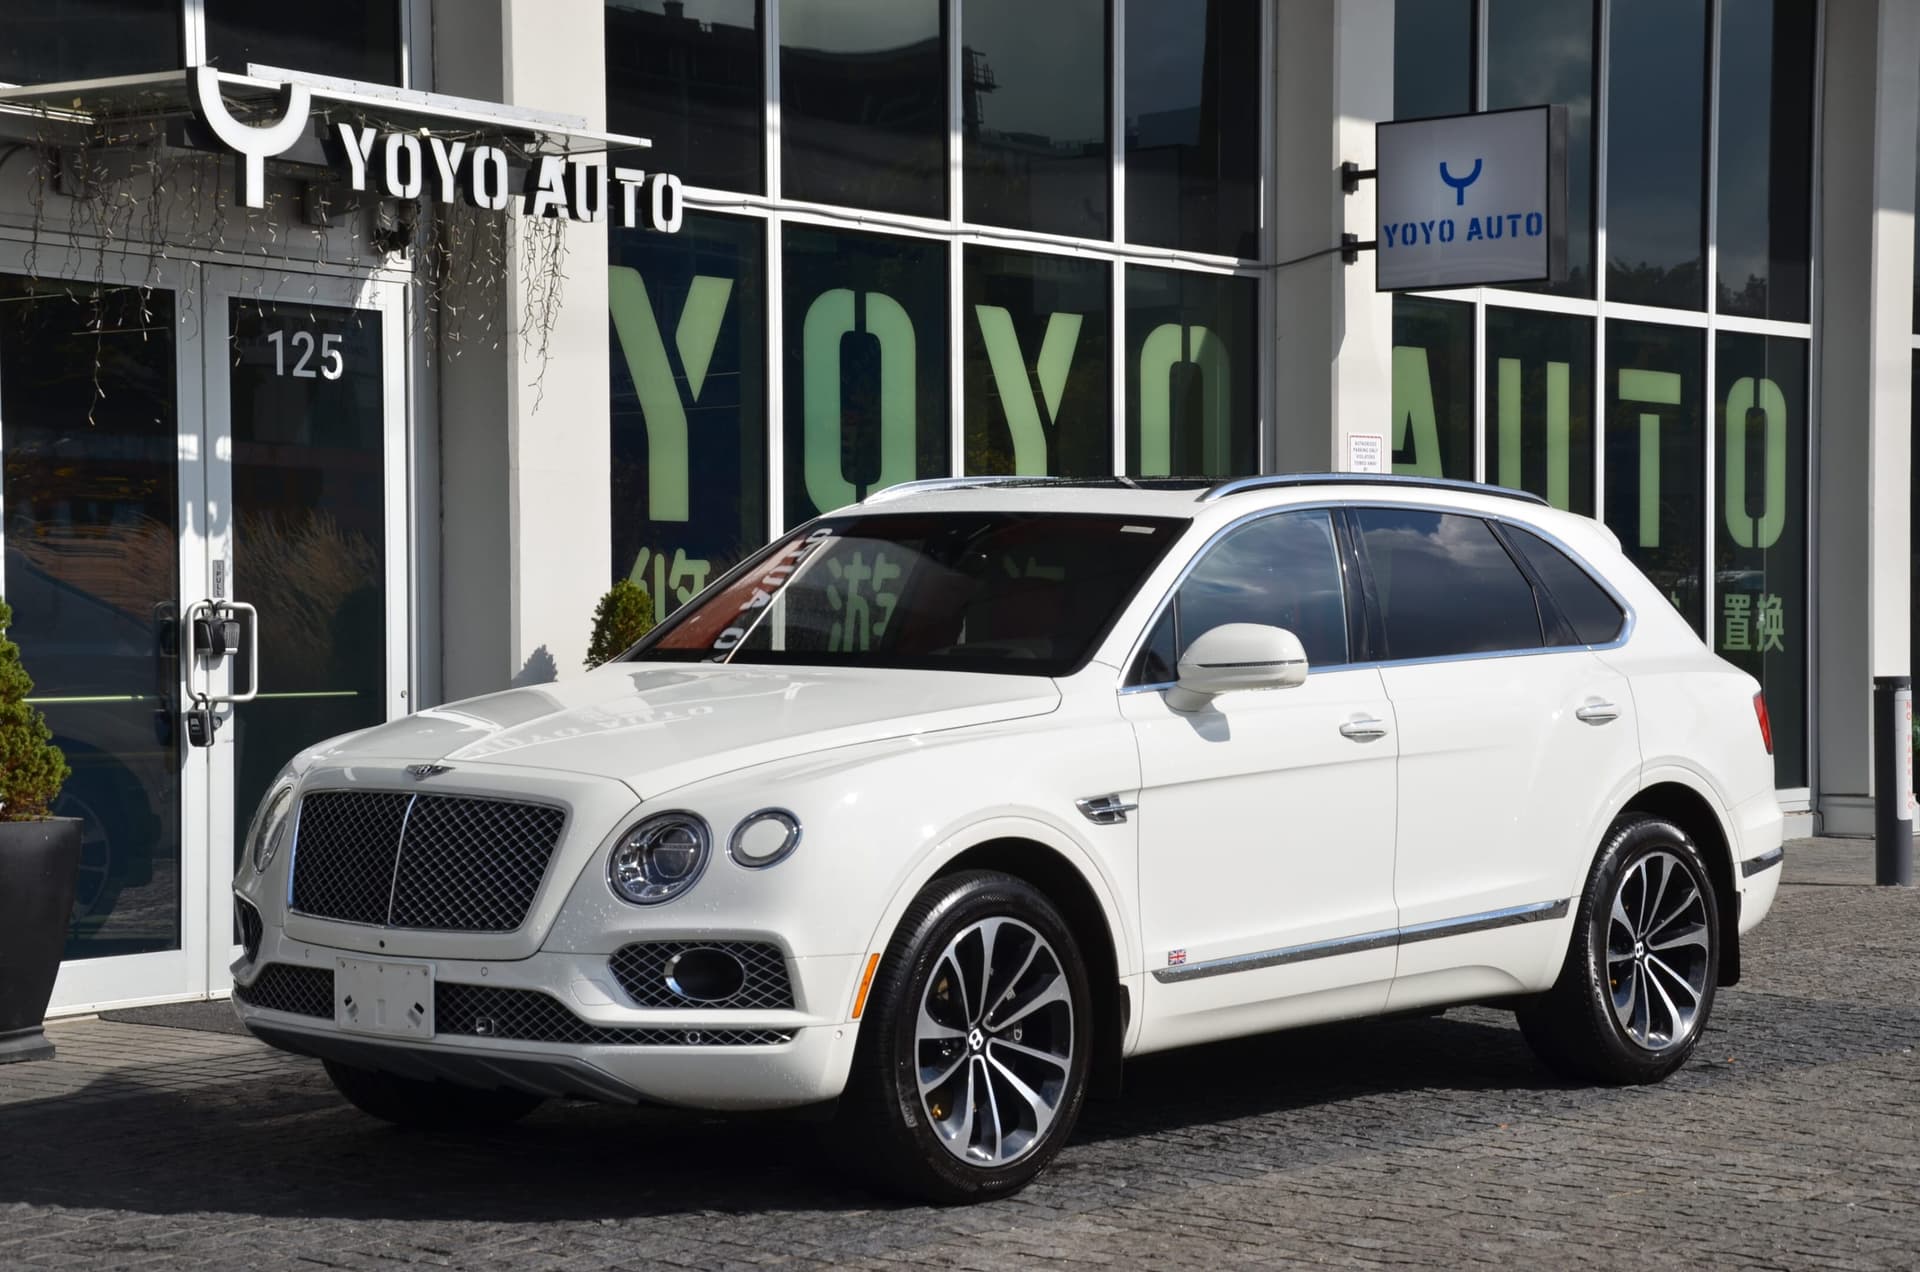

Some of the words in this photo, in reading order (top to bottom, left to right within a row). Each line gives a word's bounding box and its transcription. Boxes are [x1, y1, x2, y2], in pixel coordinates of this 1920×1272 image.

[338, 122, 509, 211] YOYO
[532, 155, 683, 234] AUTO
[1383, 219, 1455, 248] YOYO
[1466, 211, 1543, 242] AUTO
[267, 329, 344, 380] 125
[608, 265, 1231, 521] YOYO
[1722, 593, 1785, 652] 置换
